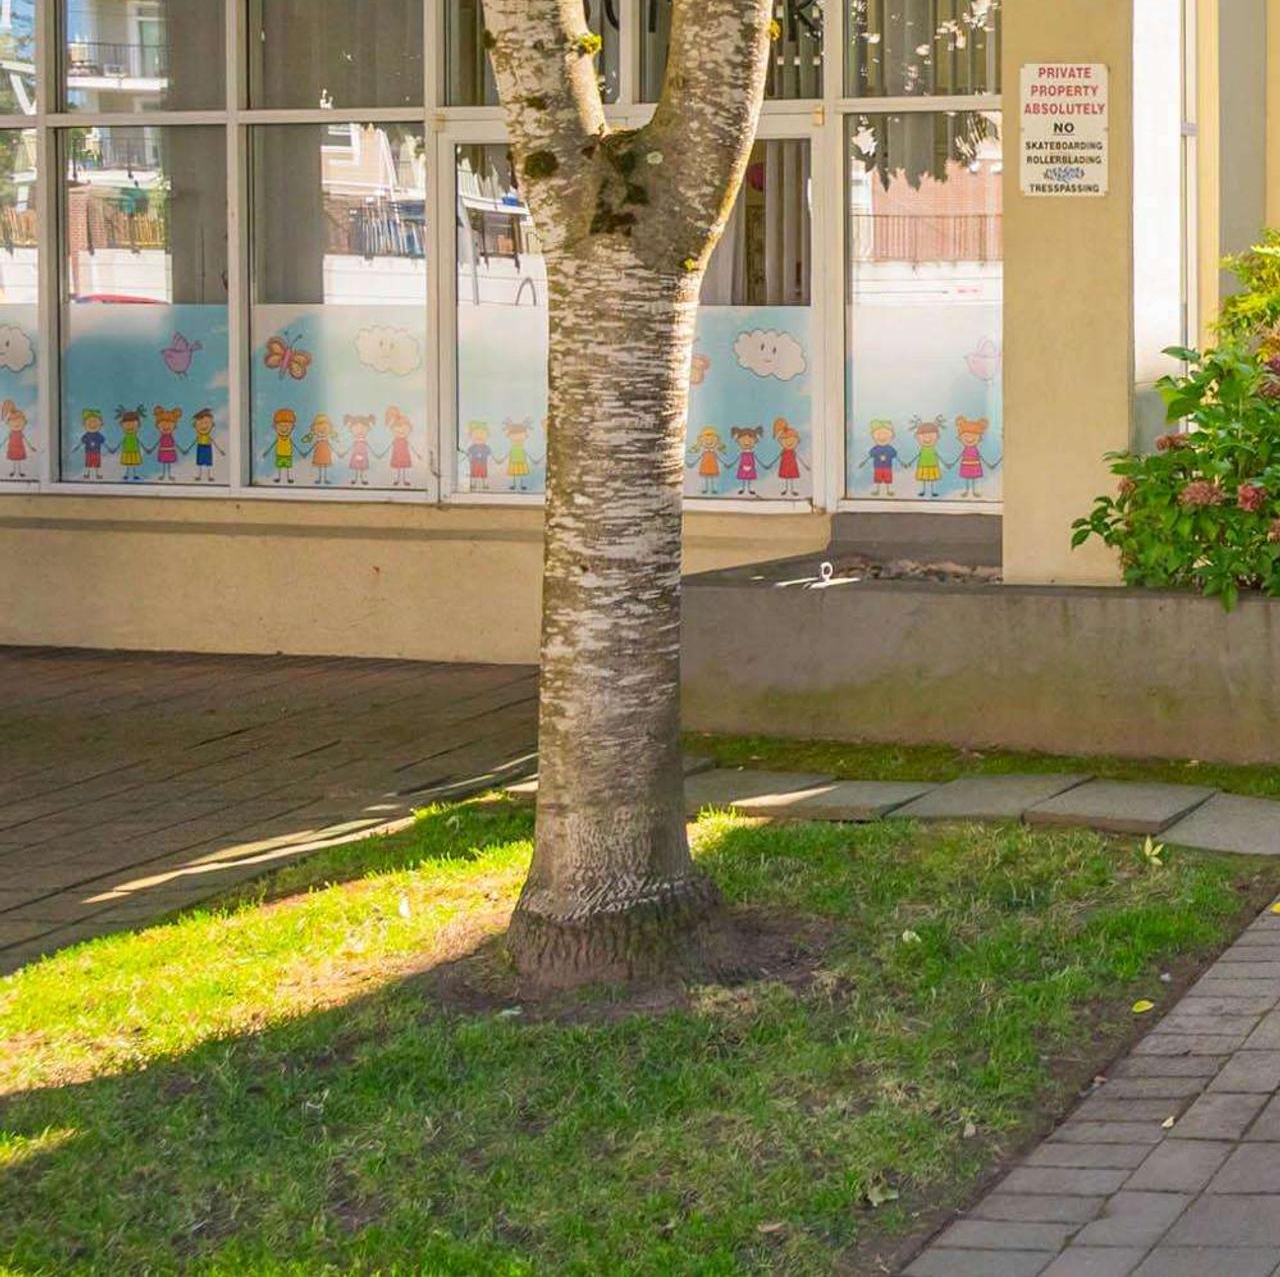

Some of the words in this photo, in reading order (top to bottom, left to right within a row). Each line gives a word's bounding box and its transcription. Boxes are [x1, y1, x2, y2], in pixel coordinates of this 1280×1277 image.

[1038, 67, 1092, 79] PRIVATE
[1030, 84, 1099, 97] PROPERTY
[1024, 102, 1105, 115] ABSOLUTELY
[1053, 122, 1075, 134] NO
[1025, 141, 1103, 151] SKATEBOARDING
[1026, 155, 1102, 164] ROLLERBLADING
[1029, 183, 1100, 193] TRESSPASSING
